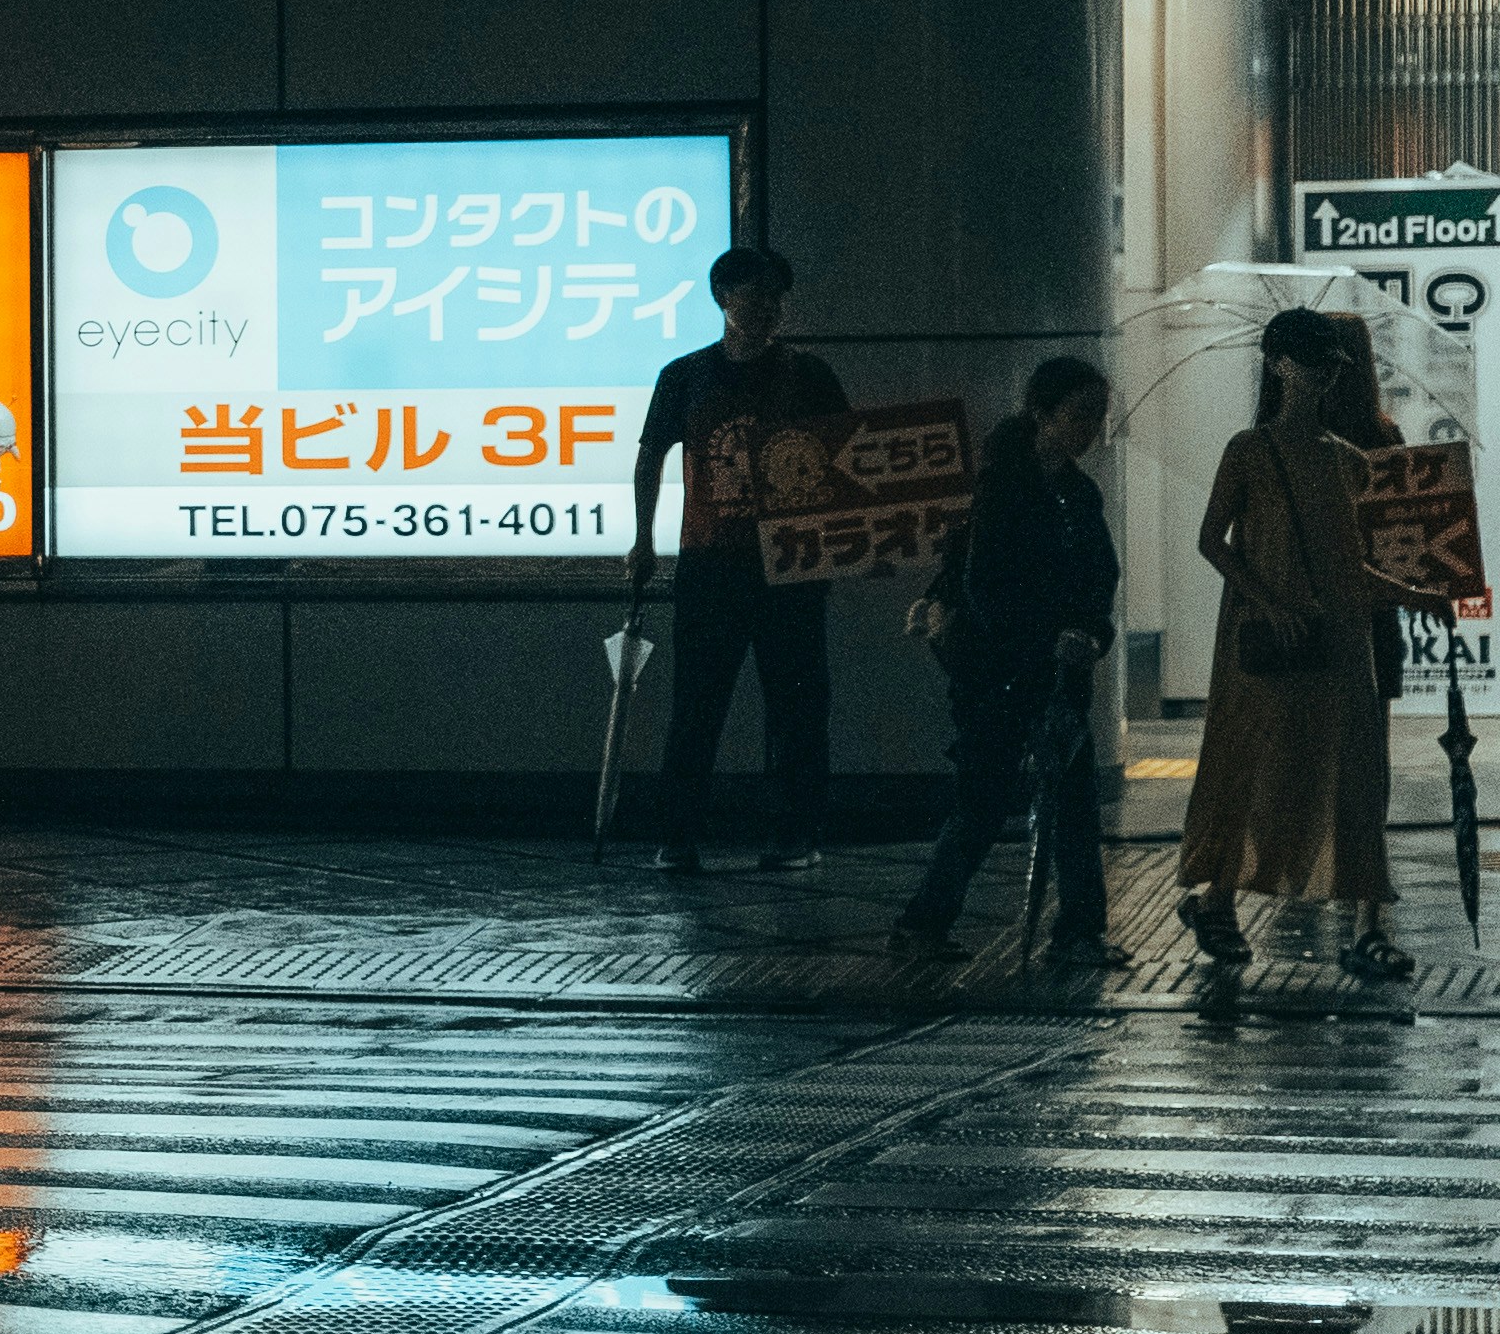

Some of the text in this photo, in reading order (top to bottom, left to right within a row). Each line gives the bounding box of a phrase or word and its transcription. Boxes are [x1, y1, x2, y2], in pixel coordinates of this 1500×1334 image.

[319, 185, 699, 252] コンタクトの
[1337, 214, 1492, 246] 2nd Floor
[320, 263, 698, 344] アイシティ
[77, 309, 250, 359] eyecity
[178, 401, 618, 476] 当ビル 3F
[850, 432, 958, 476] こちら
[178, 502, 607, 539] TEL.075-361-4011
[1402, 635, 1491, 664] KAI
